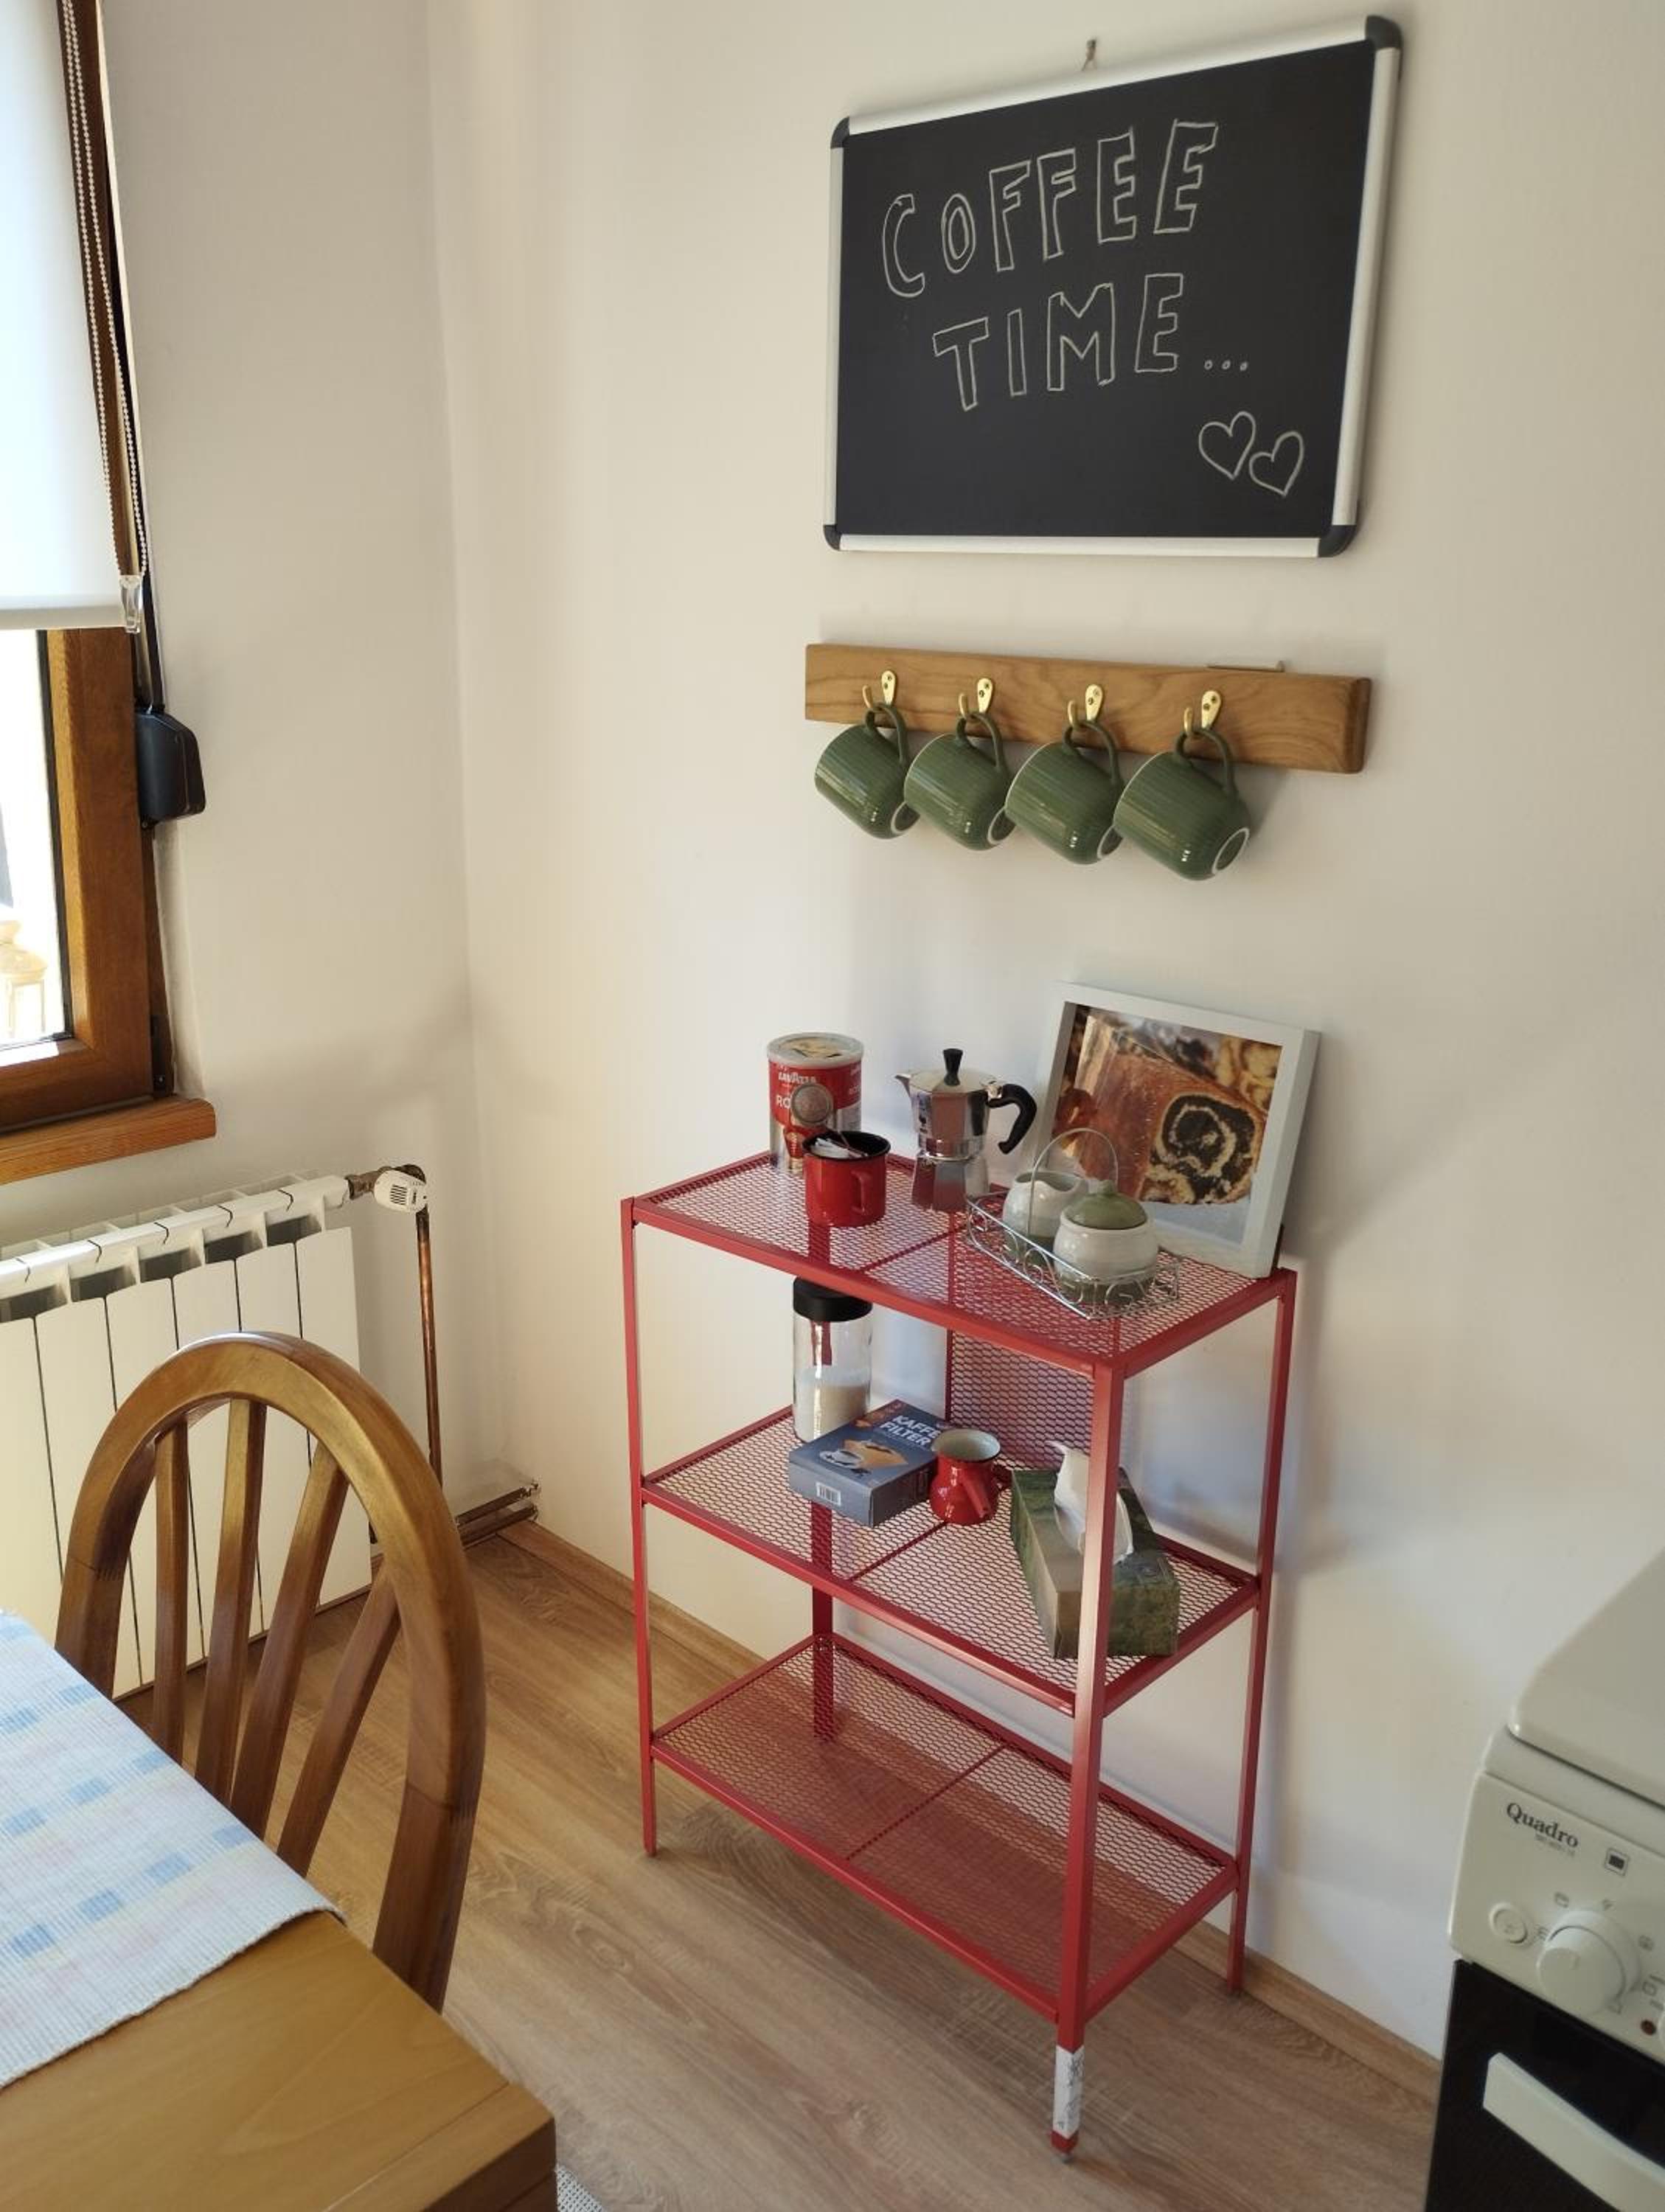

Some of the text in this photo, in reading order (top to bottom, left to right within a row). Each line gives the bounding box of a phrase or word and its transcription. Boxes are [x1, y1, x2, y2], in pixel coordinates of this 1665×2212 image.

[883, 119, 1219, 298] COFFEE
[880, 1422, 932, 1446] FILTER
[1506, 1803, 1579, 1848] Quadro
